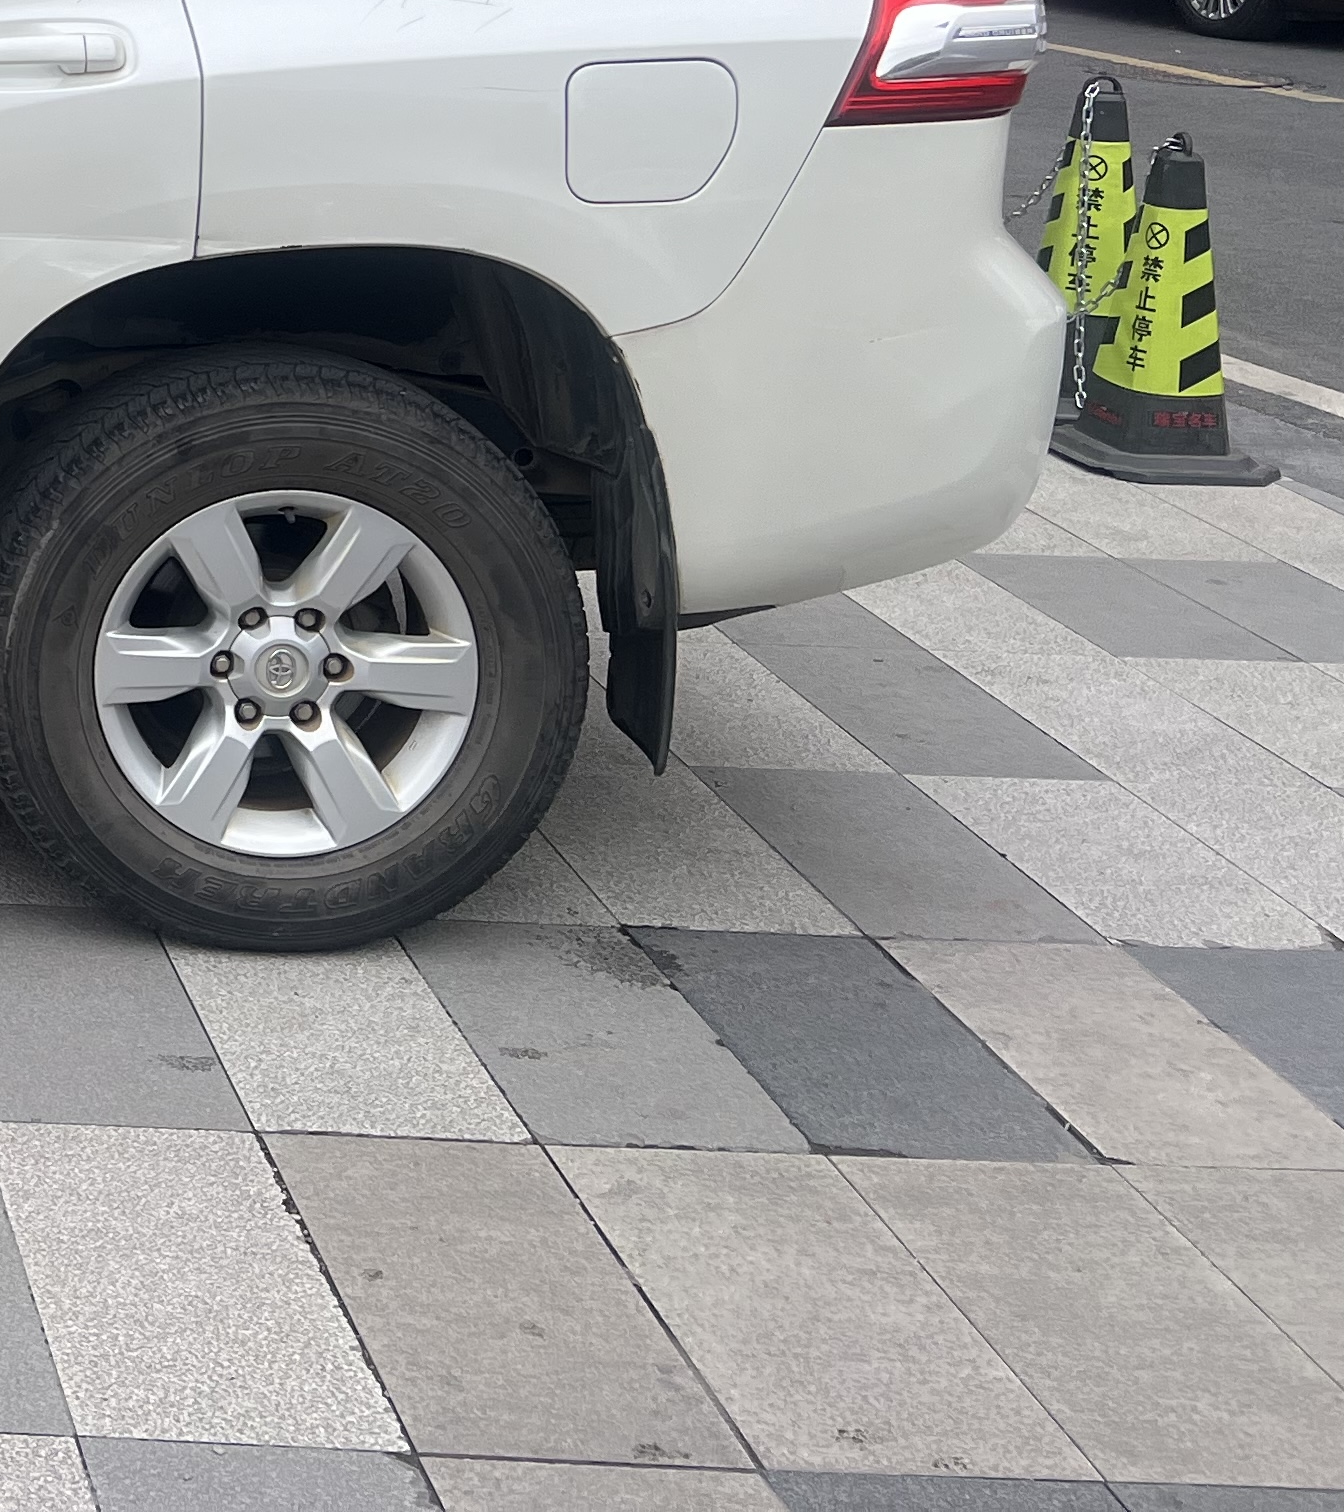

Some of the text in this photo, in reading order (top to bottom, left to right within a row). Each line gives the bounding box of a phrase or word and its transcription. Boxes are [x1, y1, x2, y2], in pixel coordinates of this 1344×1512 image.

[1126, 254, 1164, 372] 禁止停车
[83, 445, 473, 581] DUNLOP AT20
[150, 774, 503, 913] GRANDTREK
